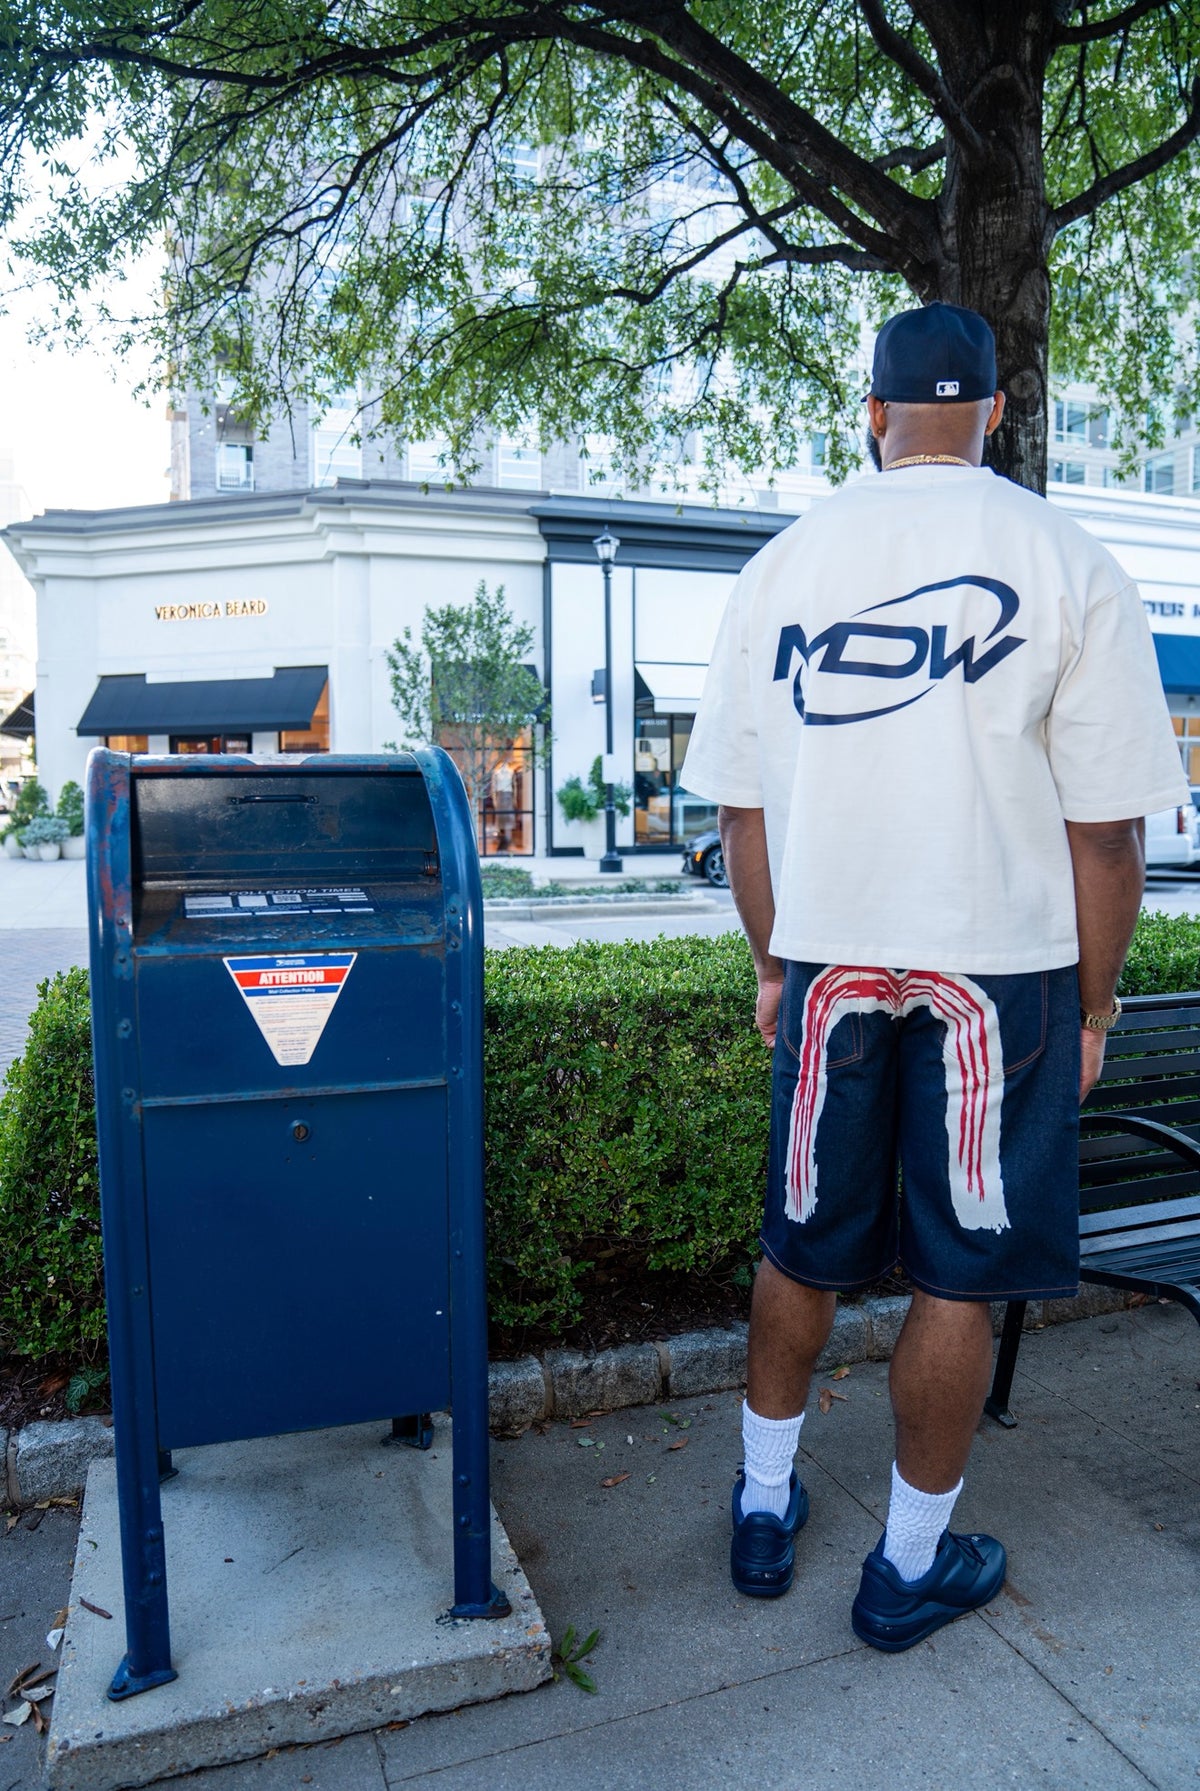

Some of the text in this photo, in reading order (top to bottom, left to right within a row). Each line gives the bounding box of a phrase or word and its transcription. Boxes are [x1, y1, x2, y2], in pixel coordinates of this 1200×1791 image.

[155, 600, 266, 620] VERONICA BEARD
[773, 622, 1028, 684] MDW
[259, 970, 325, 985] ATTENTION
